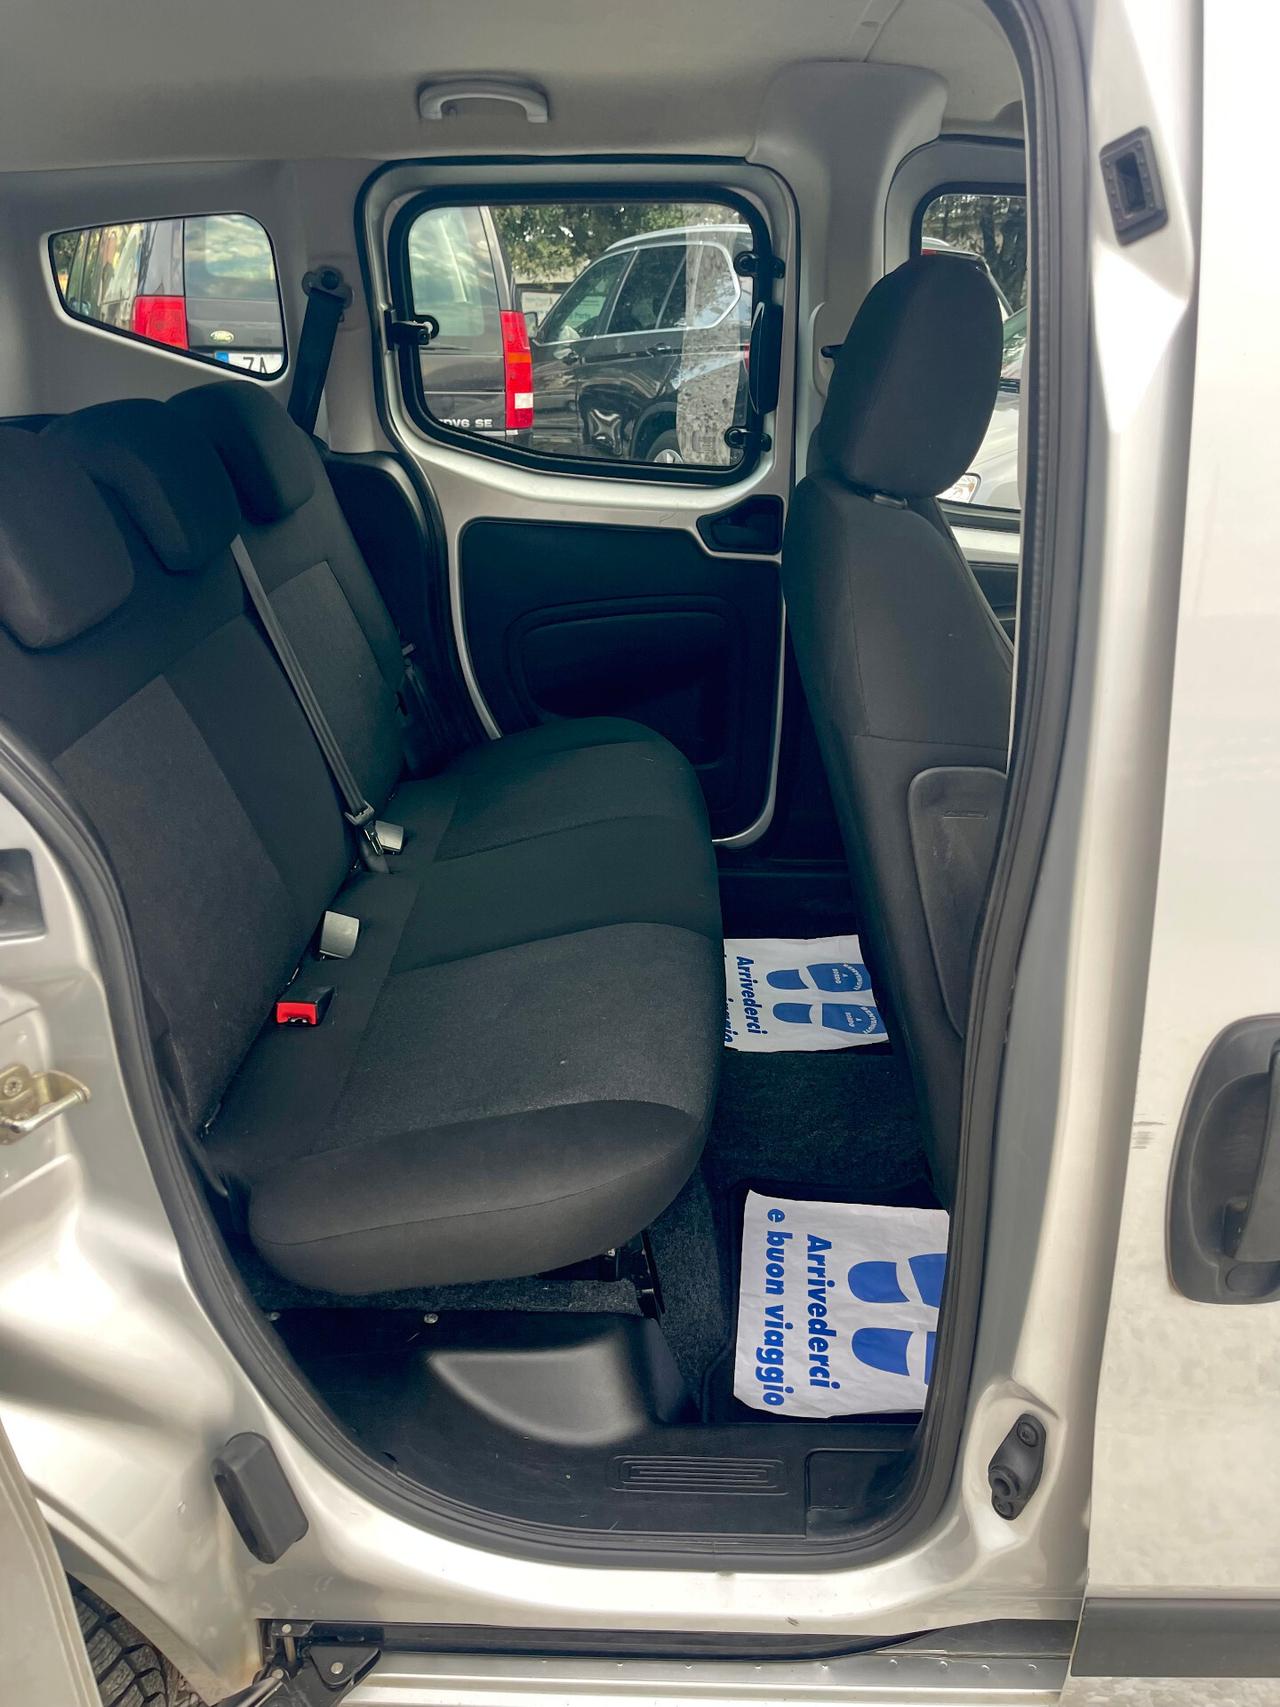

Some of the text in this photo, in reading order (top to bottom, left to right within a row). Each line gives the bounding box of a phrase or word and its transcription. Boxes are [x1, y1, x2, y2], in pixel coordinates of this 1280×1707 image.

[475, 418, 493, 428] SE
[736, 956, 768, 1034] Arrivederci
[755, 1208, 795, 1406] e buon viaggio
[807, 1234, 840, 1390] Arrivederci
